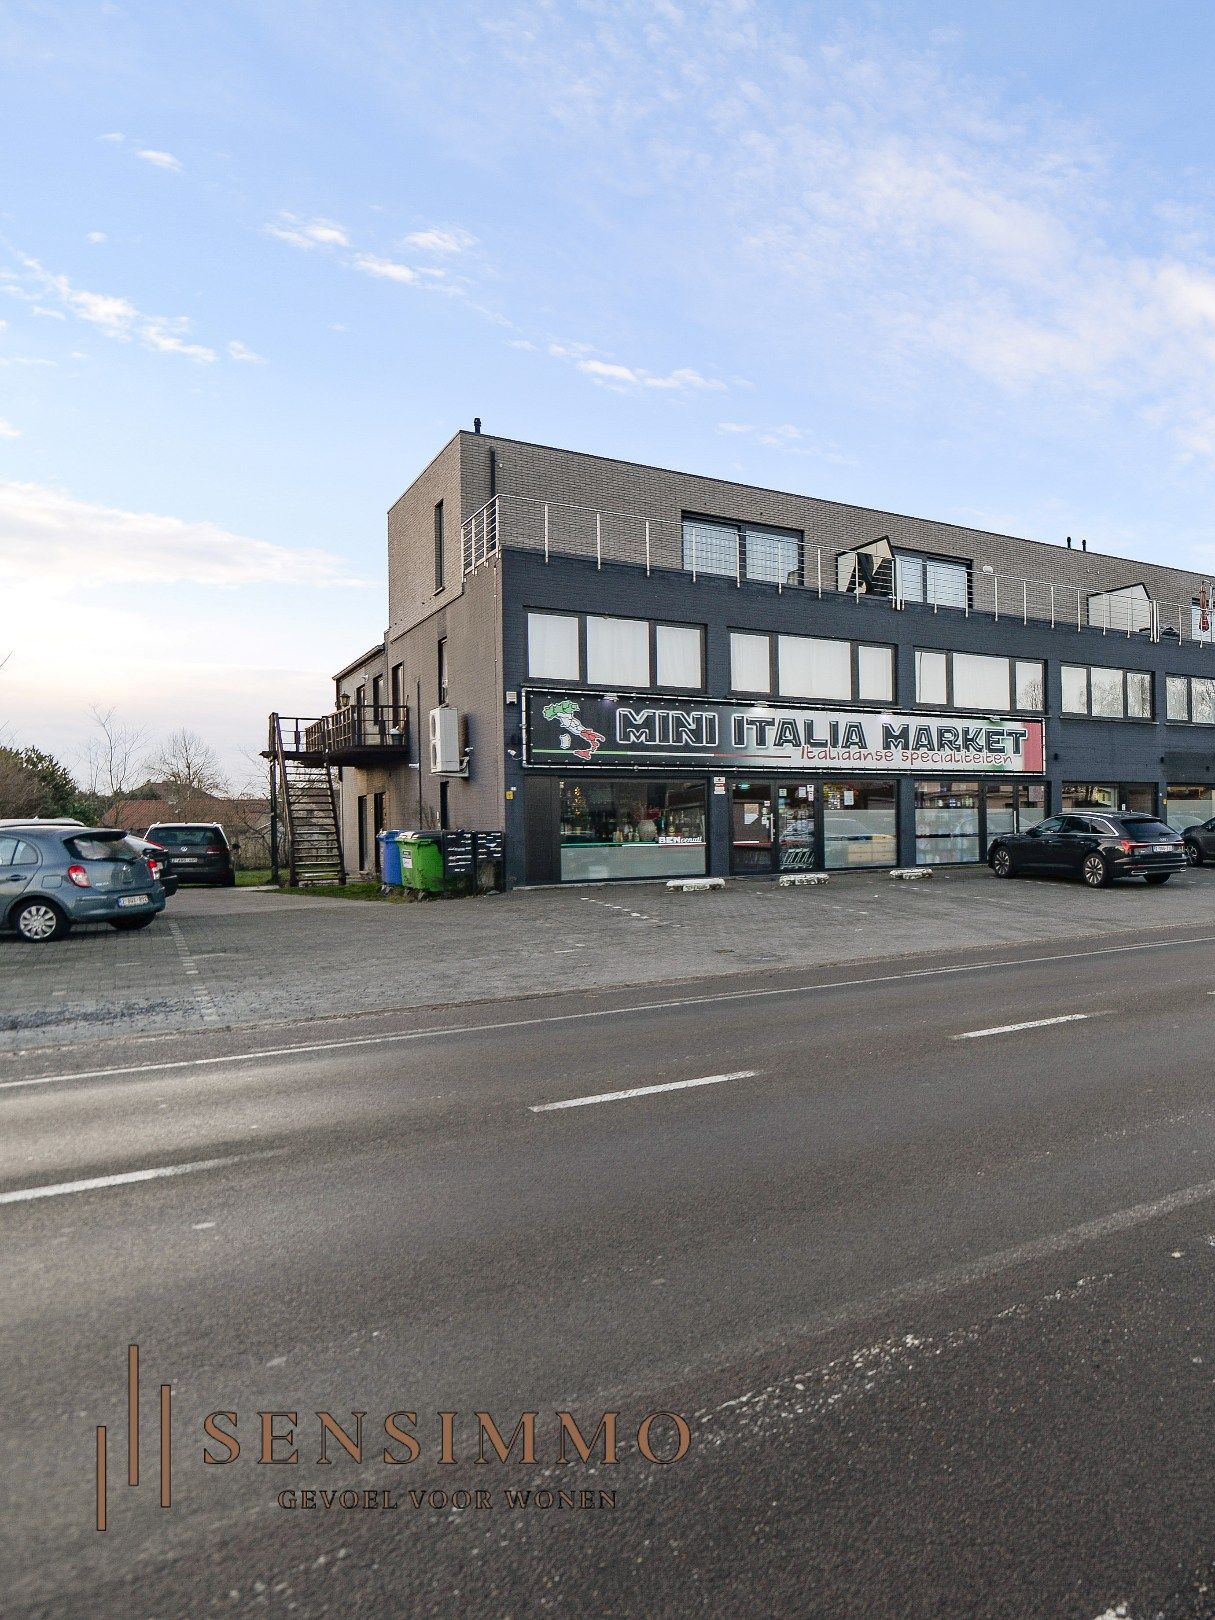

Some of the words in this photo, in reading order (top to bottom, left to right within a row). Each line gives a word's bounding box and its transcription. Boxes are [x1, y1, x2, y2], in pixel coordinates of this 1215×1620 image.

[616, 708, 718, 746] MINI
[732, 713, 868, 750] ITALIA
[881, 722, 1028, 754] MARKET
[801, 746, 894, 763] Italiaanse
[901, 749, 1013, 766] specialiteiten
